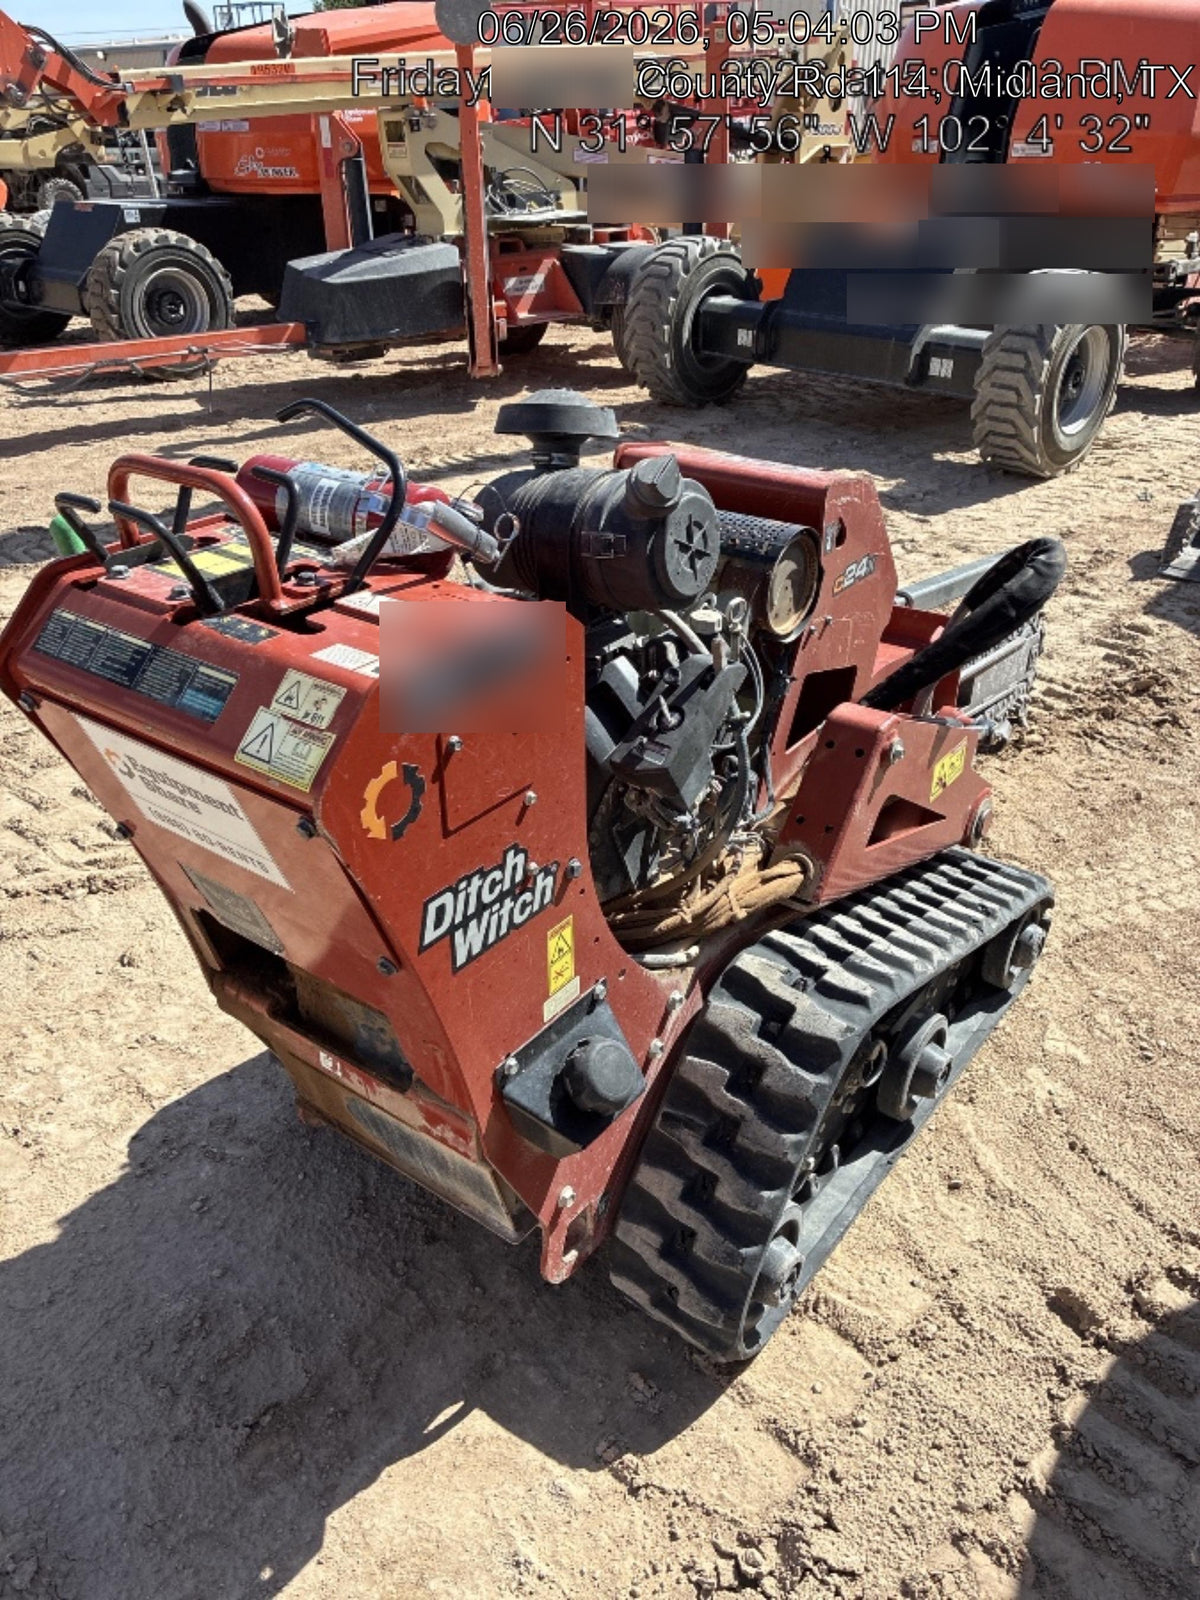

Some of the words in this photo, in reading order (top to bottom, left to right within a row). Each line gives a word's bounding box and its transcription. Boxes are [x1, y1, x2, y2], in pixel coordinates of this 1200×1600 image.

[124, 753, 244, 821] Equipment
[420, 846, 527, 950] Ditch
[452, 868, 556, 970] Witch
